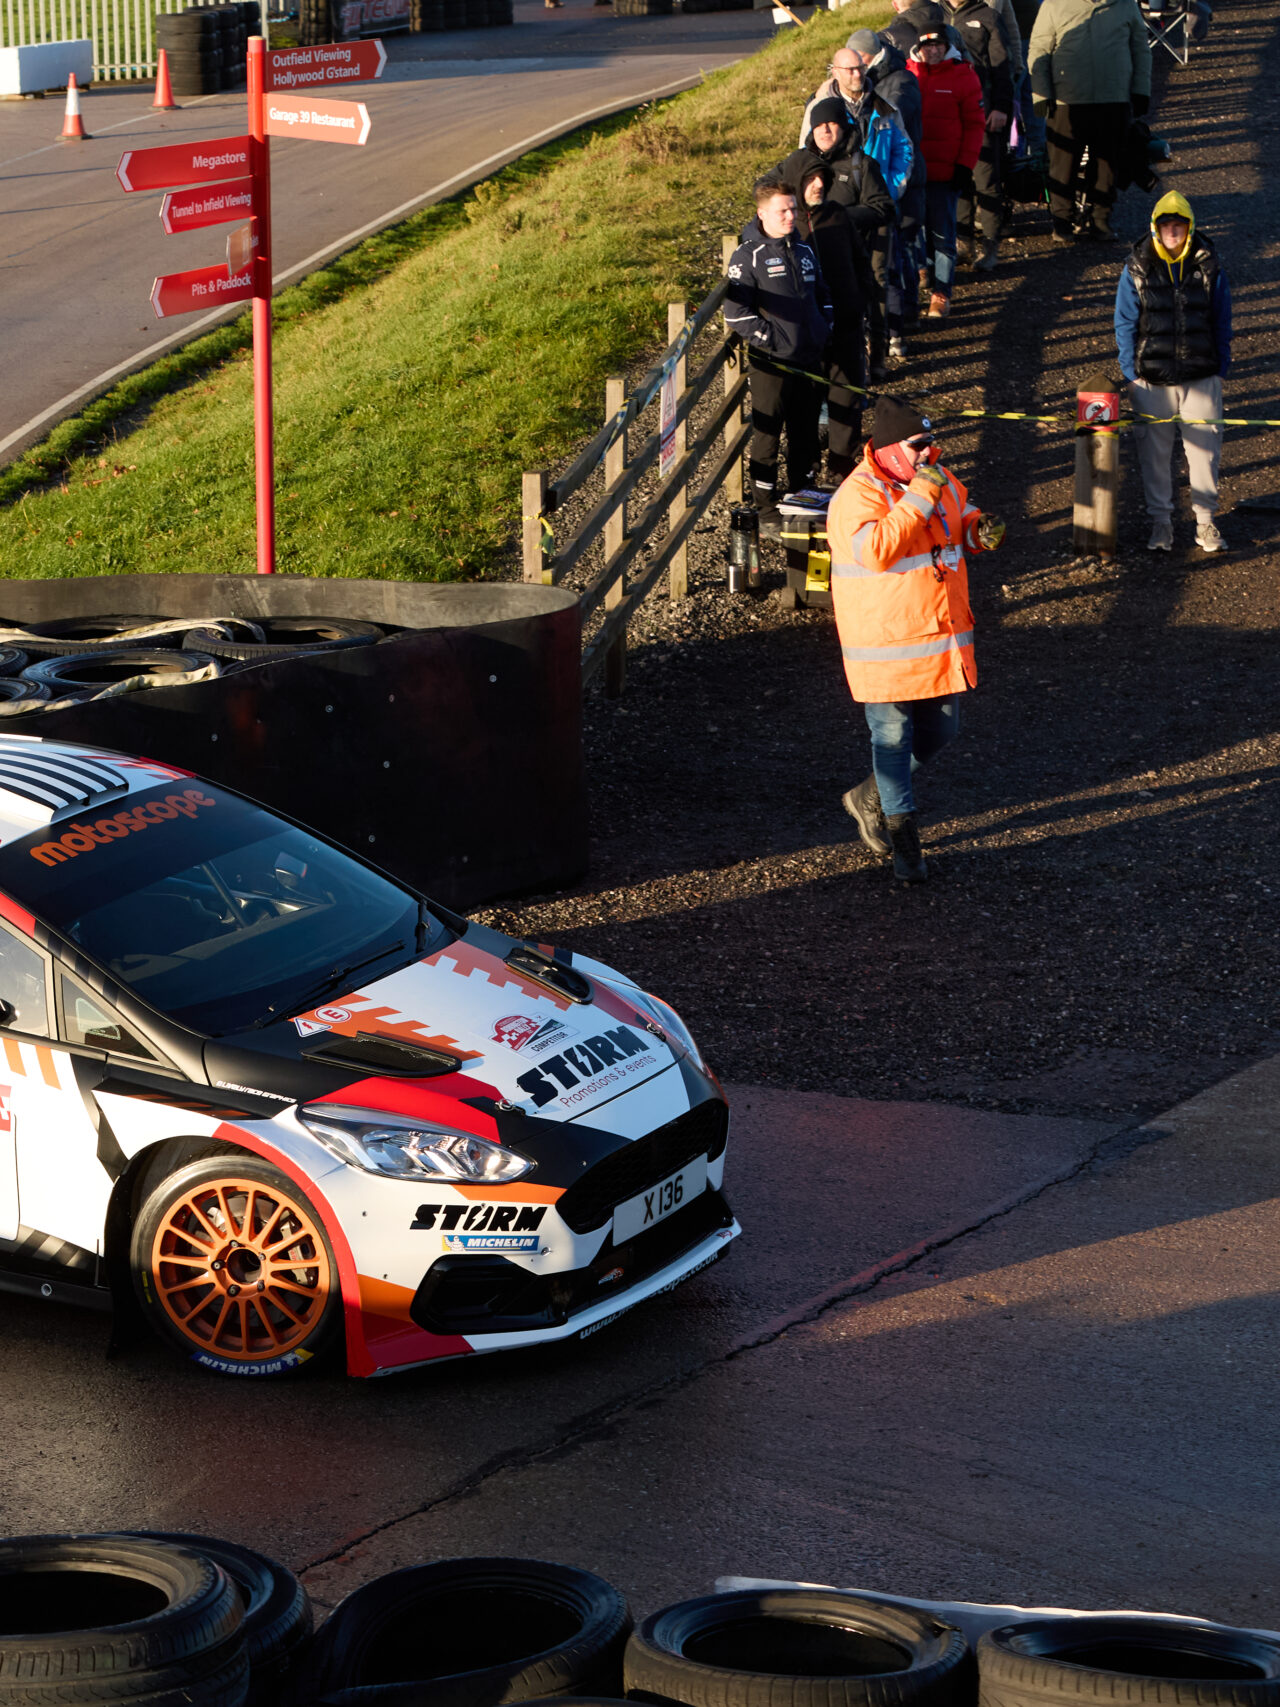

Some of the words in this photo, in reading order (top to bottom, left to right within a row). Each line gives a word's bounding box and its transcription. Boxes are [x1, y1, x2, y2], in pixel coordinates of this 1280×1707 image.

[273, 51, 312, 67] Outfield
[313, 48, 351, 62] Viewing
[273, 68, 324, 86] Hollywood
[326, 63, 360, 79] G'stand
[270, 107, 299, 125] Garage
[299, 110, 310, 123] 39
[311, 112, 355, 128] Restaurant
[192, 152, 246, 169] Megastore
[172, 202, 194, 218] Tunnel
[195, 202, 203, 214] to
[203, 196, 224, 211] Infield
[225, 192, 251, 206] Viewing
[192, 283, 207, 296] Pits
[208, 281, 215, 292] &
[217, 273, 251, 291] Paddock
[30, 790, 216, 867] motoscope
[323, 1009, 344, 1020] E
[531, 1031, 569, 1052] COMPETITOR
[517, 1025, 650, 1108] STORM
[560, 1072, 619, 1107] Promotions
[614, 1067, 626, 1077] &
[627, 1054, 657, 1073] events
[643, 1192, 654, 1224] X
[659, 1174, 683, 1215] 136
[410, 1204, 548, 1231] STORM
[467, 1238, 534, 1247] MICHELIN
[198, 1355, 282, 1375] MICHELIN
